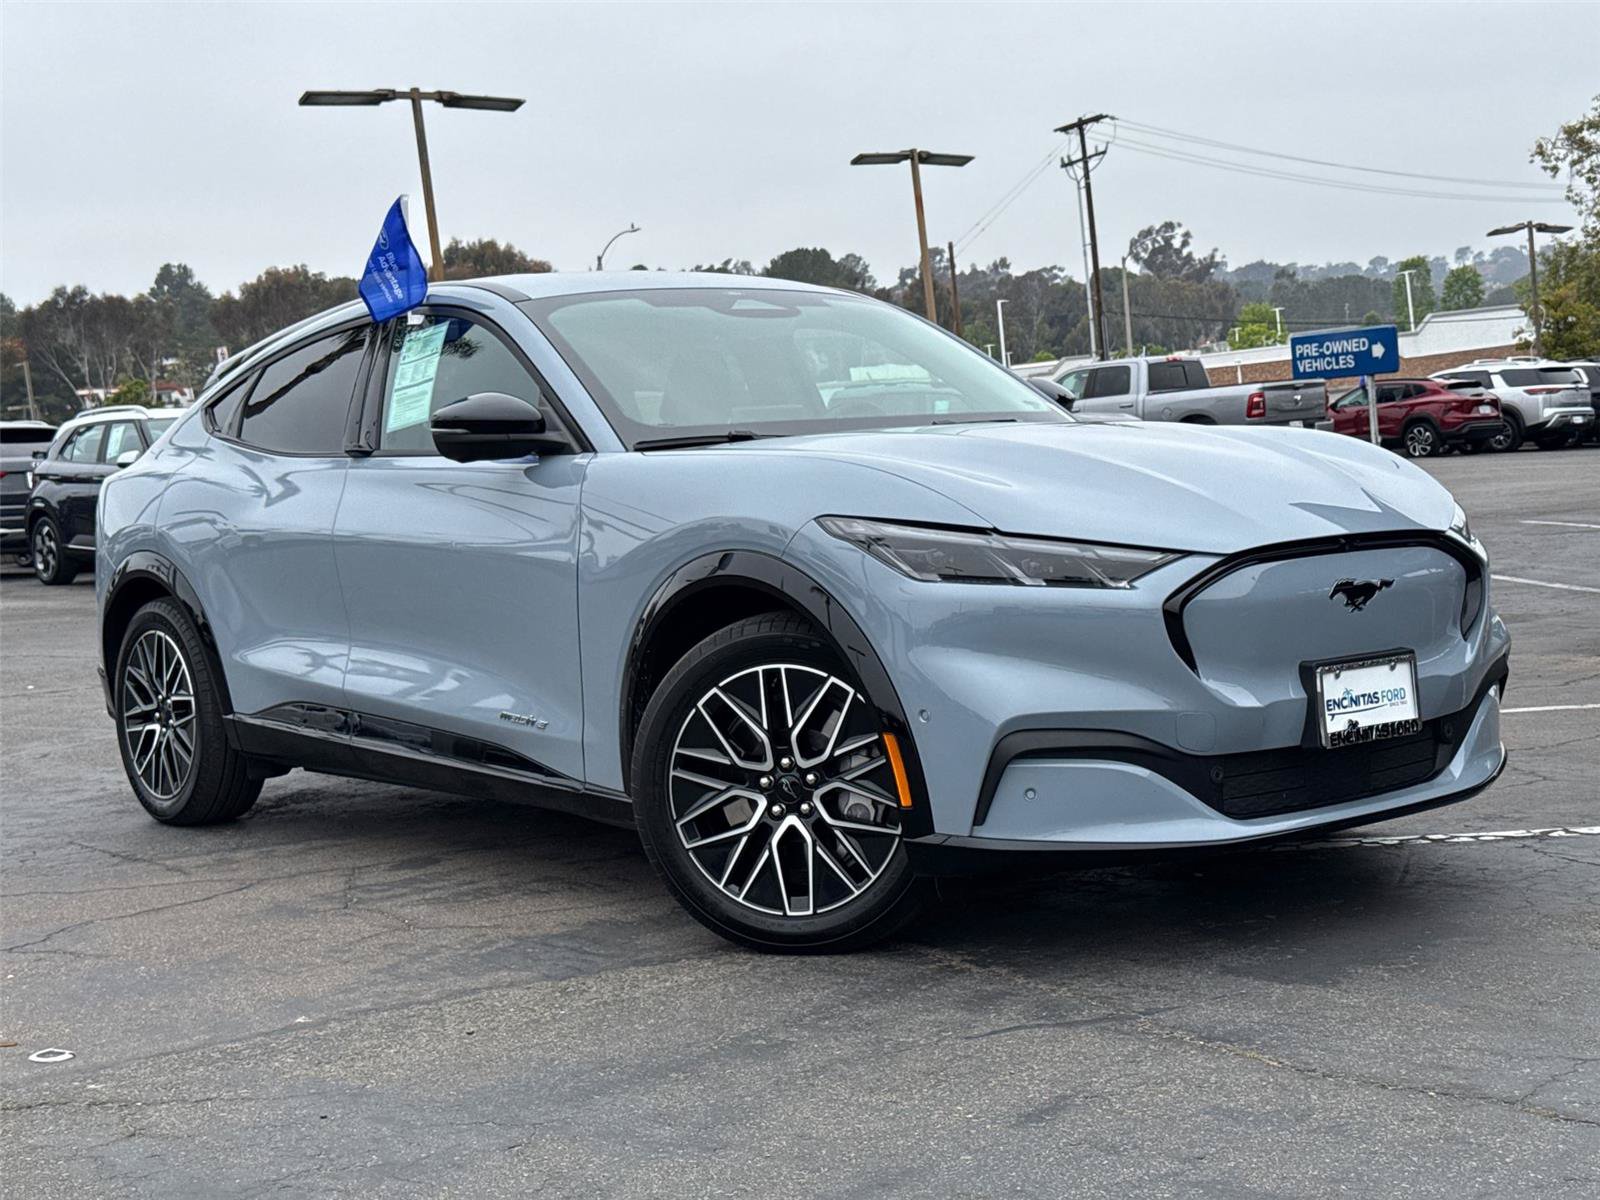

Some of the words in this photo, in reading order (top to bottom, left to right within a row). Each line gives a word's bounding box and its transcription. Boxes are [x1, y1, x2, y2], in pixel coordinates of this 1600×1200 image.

[378, 255, 404, 300] Advantage
[1295, 338, 1368, 358] PRE-OWNED
[1297, 355, 1355, 372] VEHICLES
[1326, 690, 1380, 712] ENCINITAS
[1381, 687, 1406, 702] FORD
